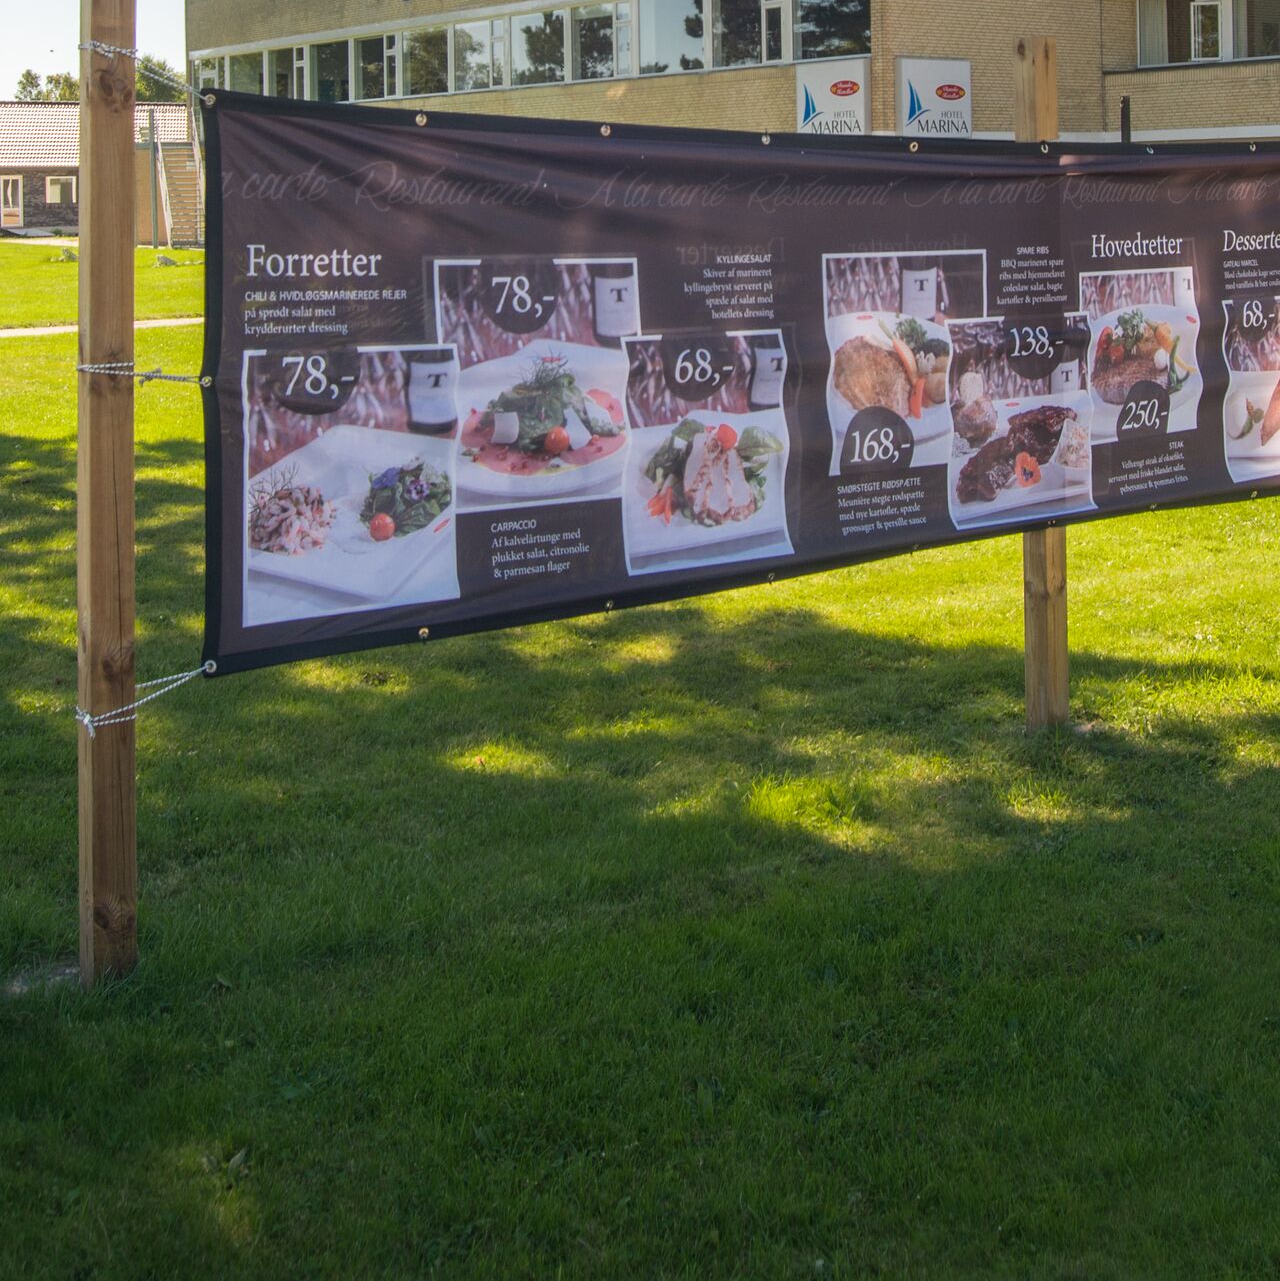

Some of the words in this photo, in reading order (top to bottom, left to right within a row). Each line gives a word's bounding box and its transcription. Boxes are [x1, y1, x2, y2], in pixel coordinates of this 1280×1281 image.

[833, 110, 857, 119] HOTEL
[940, 111, 964, 119] HOTEL
[811, 119, 862, 135] MARINA
[917, 119, 969, 134] MARINA
[332, 160, 545, 213] Restaurant
[1016, 246, 1035, 255] SPARE
[1036, 245, 1050, 255] RIBS
[1091, 231, 1183, 258] Hovedretter
[246, 244, 382, 277] Forretter
[716, 254, 772, 264] KYLLINGESALAT
[1001, 259, 1017, 269] BBQ
[1017, 258, 1048, 268] marineret
[1048, 258, 1064, 269] spare
[703, 268, 726, 279] Skiver
[727, 268, 735, 278] af
[736, 268, 772, 278] marineret
[1012, 271, 1027, 280] med
[683, 282, 733, 296] kyllingebryst
[733, 281, 763, 292] serveret
[763, 280, 774, 293] på
[914, 278, 929, 293] T
[244, 290, 268, 302] CHILI
[269, 290, 277, 301] &
[279, 289, 380, 301] HVIDLØGSMARINEREDE
[382, 289, 407, 300] REJER
[492, 275, 555, 319] 78,-
[610, 287, 629, 304] T
[730, 294, 738, 305] af
[739, 294, 756, 305] salat
[757, 294, 774, 304] med
[1025, 295, 1031, 304] &
[244, 306, 256, 320] på
[258, 305, 290, 320] sprødt
[291, 305, 313, 318] salat
[314, 305, 336, 317] med
[711, 309, 743, 320] hotellets
[744, 308, 775, 320] dressing
[1243, 300, 1275, 330] 68,-
[244, 322, 307, 337] krydderurter
[308, 322, 349, 336] dressing
[1010, 325, 1064, 359] 138,-
[674, 348, 734, 387] 68,-
[282, 355, 355, 400] 78,-
[427, 372, 448, 388] T
[1121, 398, 1168, 430] 250,-
[850, 427, 911, 464] 168,-
[1169, 441, 1184, 451] STEAK
[837, 481, 881, 495] SMØRSTEGTE
[881, 477, 921, 490] RØDSPÆTTE
[839, 510, 855, 521] med
[491, 519, 537, 533] CARPACCIO
[492, 537, 503, 548] Af
[504, 532, 561, 547] kalvelårtunge
[562, 528, 581, 540] med
[492, 550, 525, 566] plukket
[526, 547, 548, 560] salat,
[549, 542, 590, 557] citronolie
[493, 568, 503, 579] &
[503, 564, 546, 580] parmesan
[547, 560, 571, 575] flager
